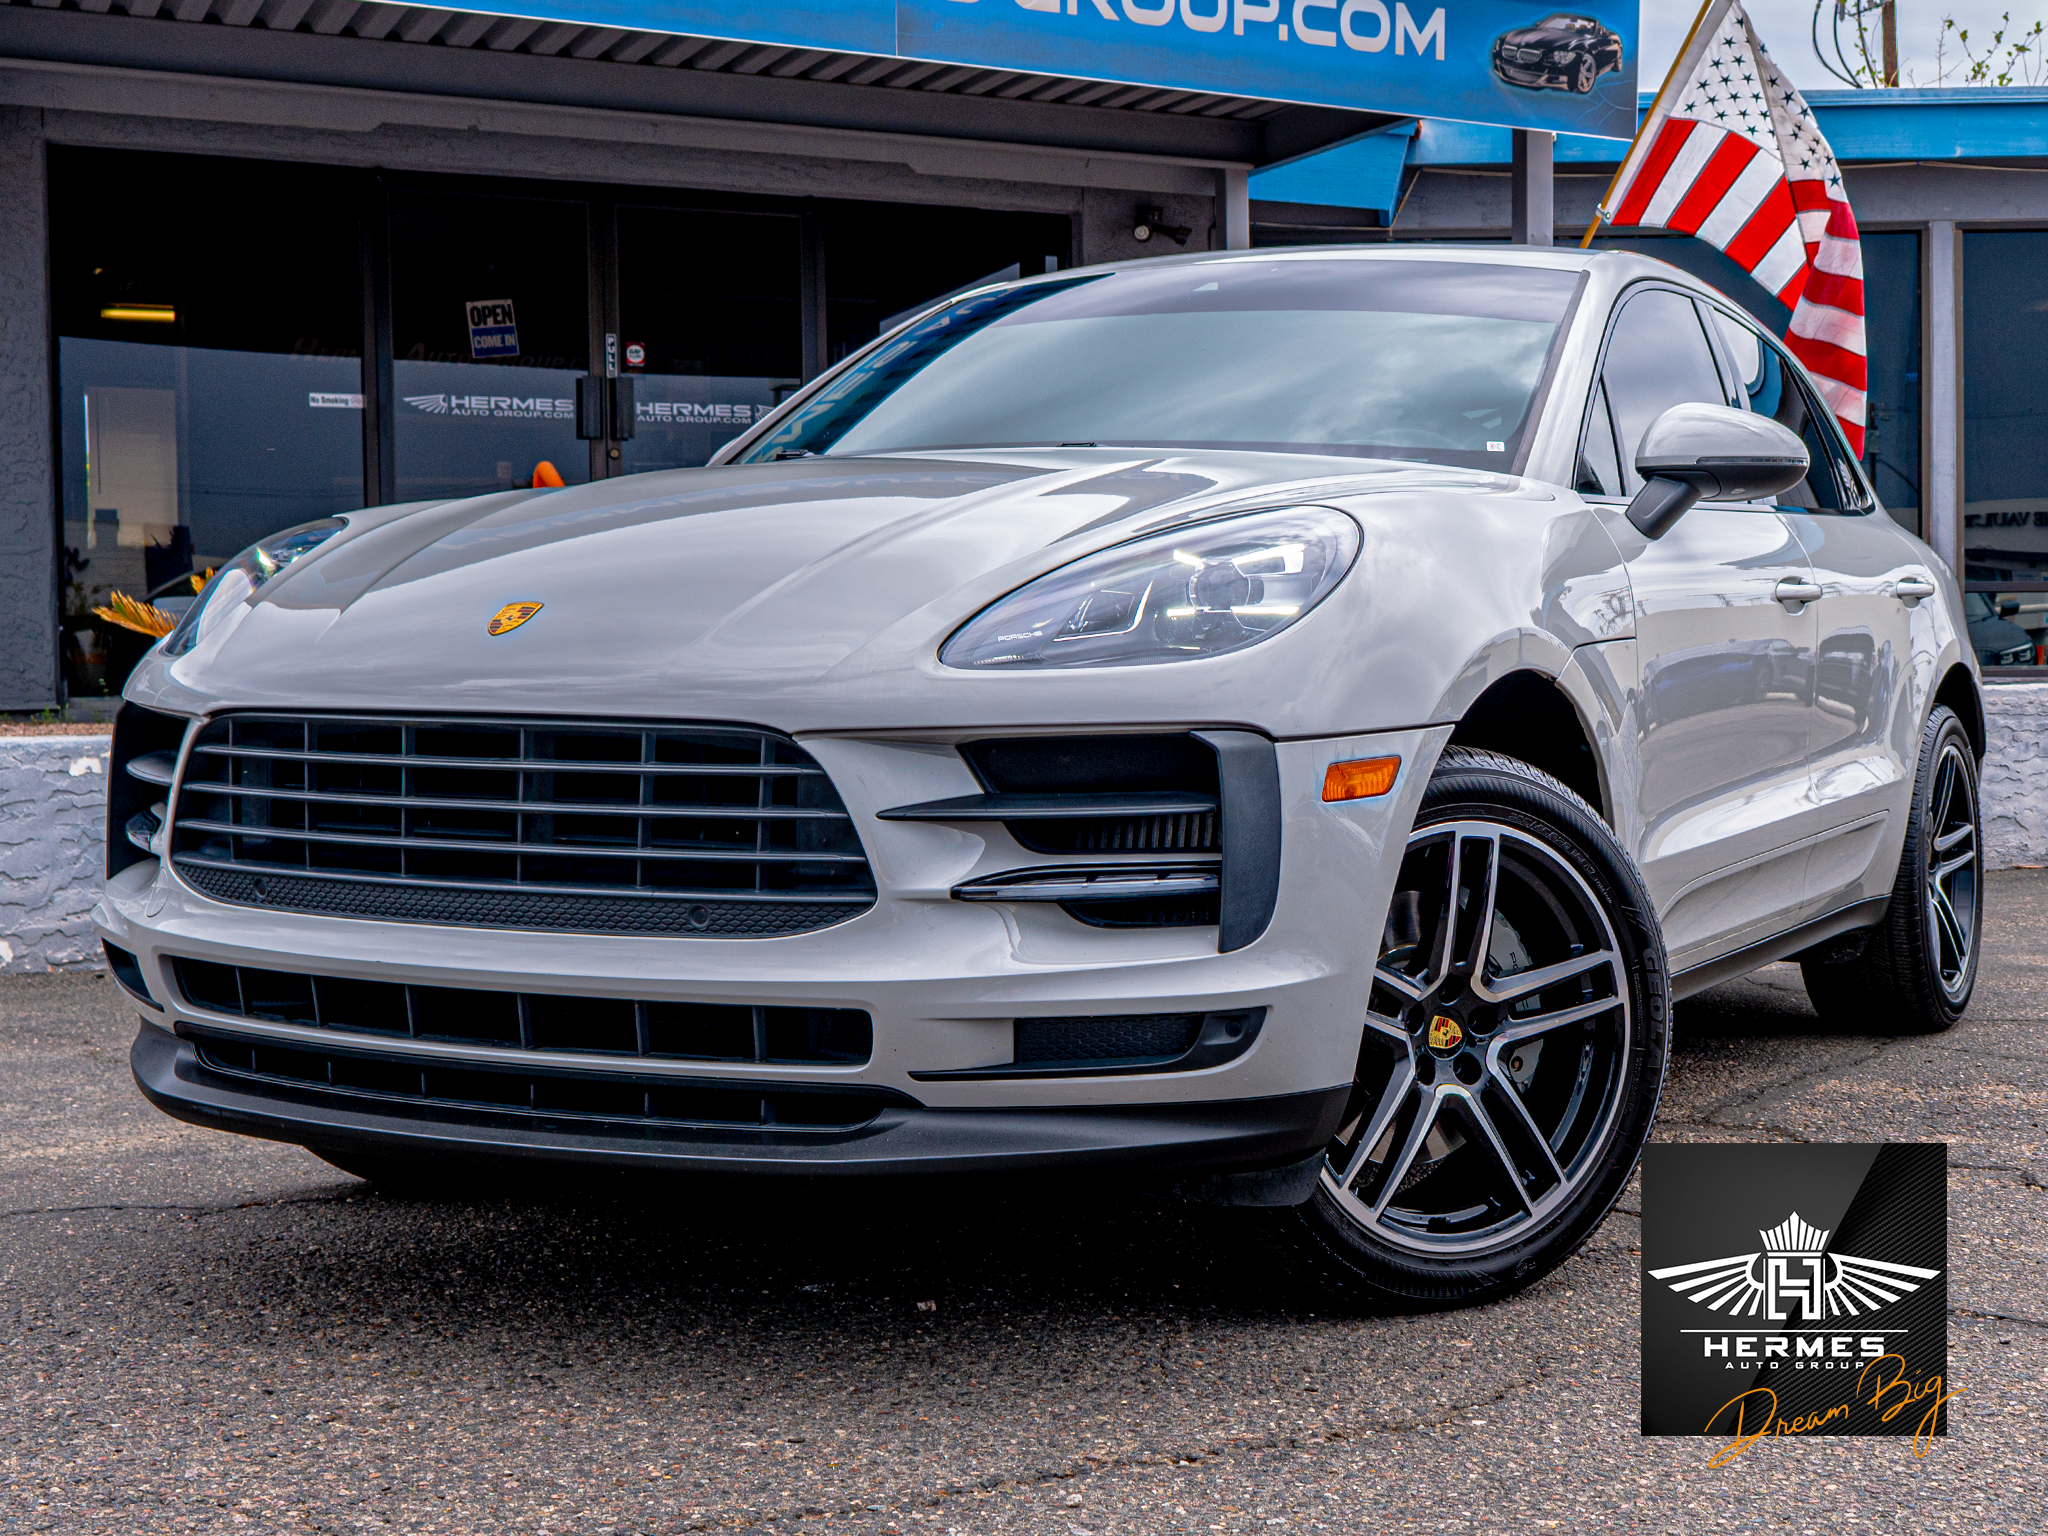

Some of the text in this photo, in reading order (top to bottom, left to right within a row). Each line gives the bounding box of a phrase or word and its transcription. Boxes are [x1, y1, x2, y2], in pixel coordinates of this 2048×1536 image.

[470, 304, 514, 326] OPEN
[474, 334, 515, 348] COME IN
[607, 336, 616, 371] PULL
[311, 396, 349, 406] No Smoking
[451, 395, 574, 411] HERMES
[452, 408, 574, 419] AUTO GROUP.COM
[635, 402, 752, 417] HERMES
[636, 415, 752, 424] AUTO GROUP.COM
[997, 630, 1043, 642] PORSCHE
